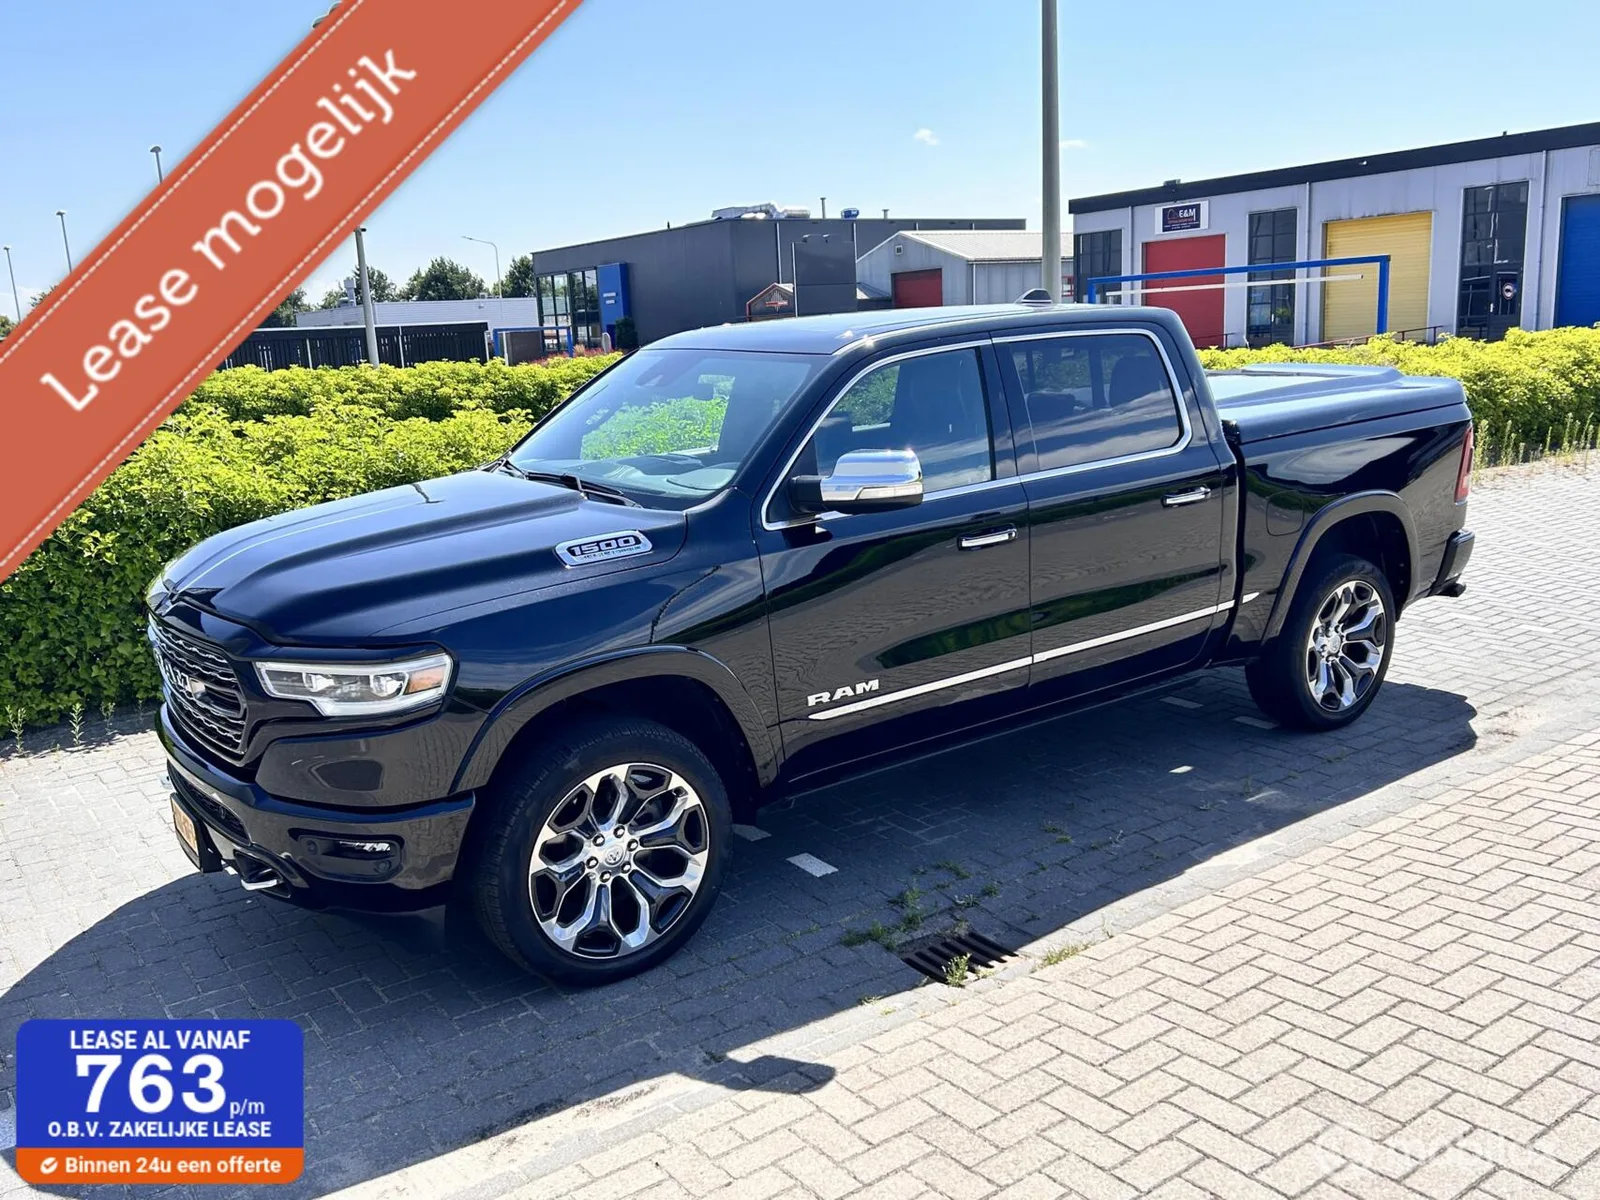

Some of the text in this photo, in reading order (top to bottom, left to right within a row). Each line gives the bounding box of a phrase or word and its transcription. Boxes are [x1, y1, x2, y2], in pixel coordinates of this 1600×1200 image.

[1179, 208, 1196, 221] E&M
[571, 536, 636, 556] 1500
[807, 679, 879, 706] RAM
